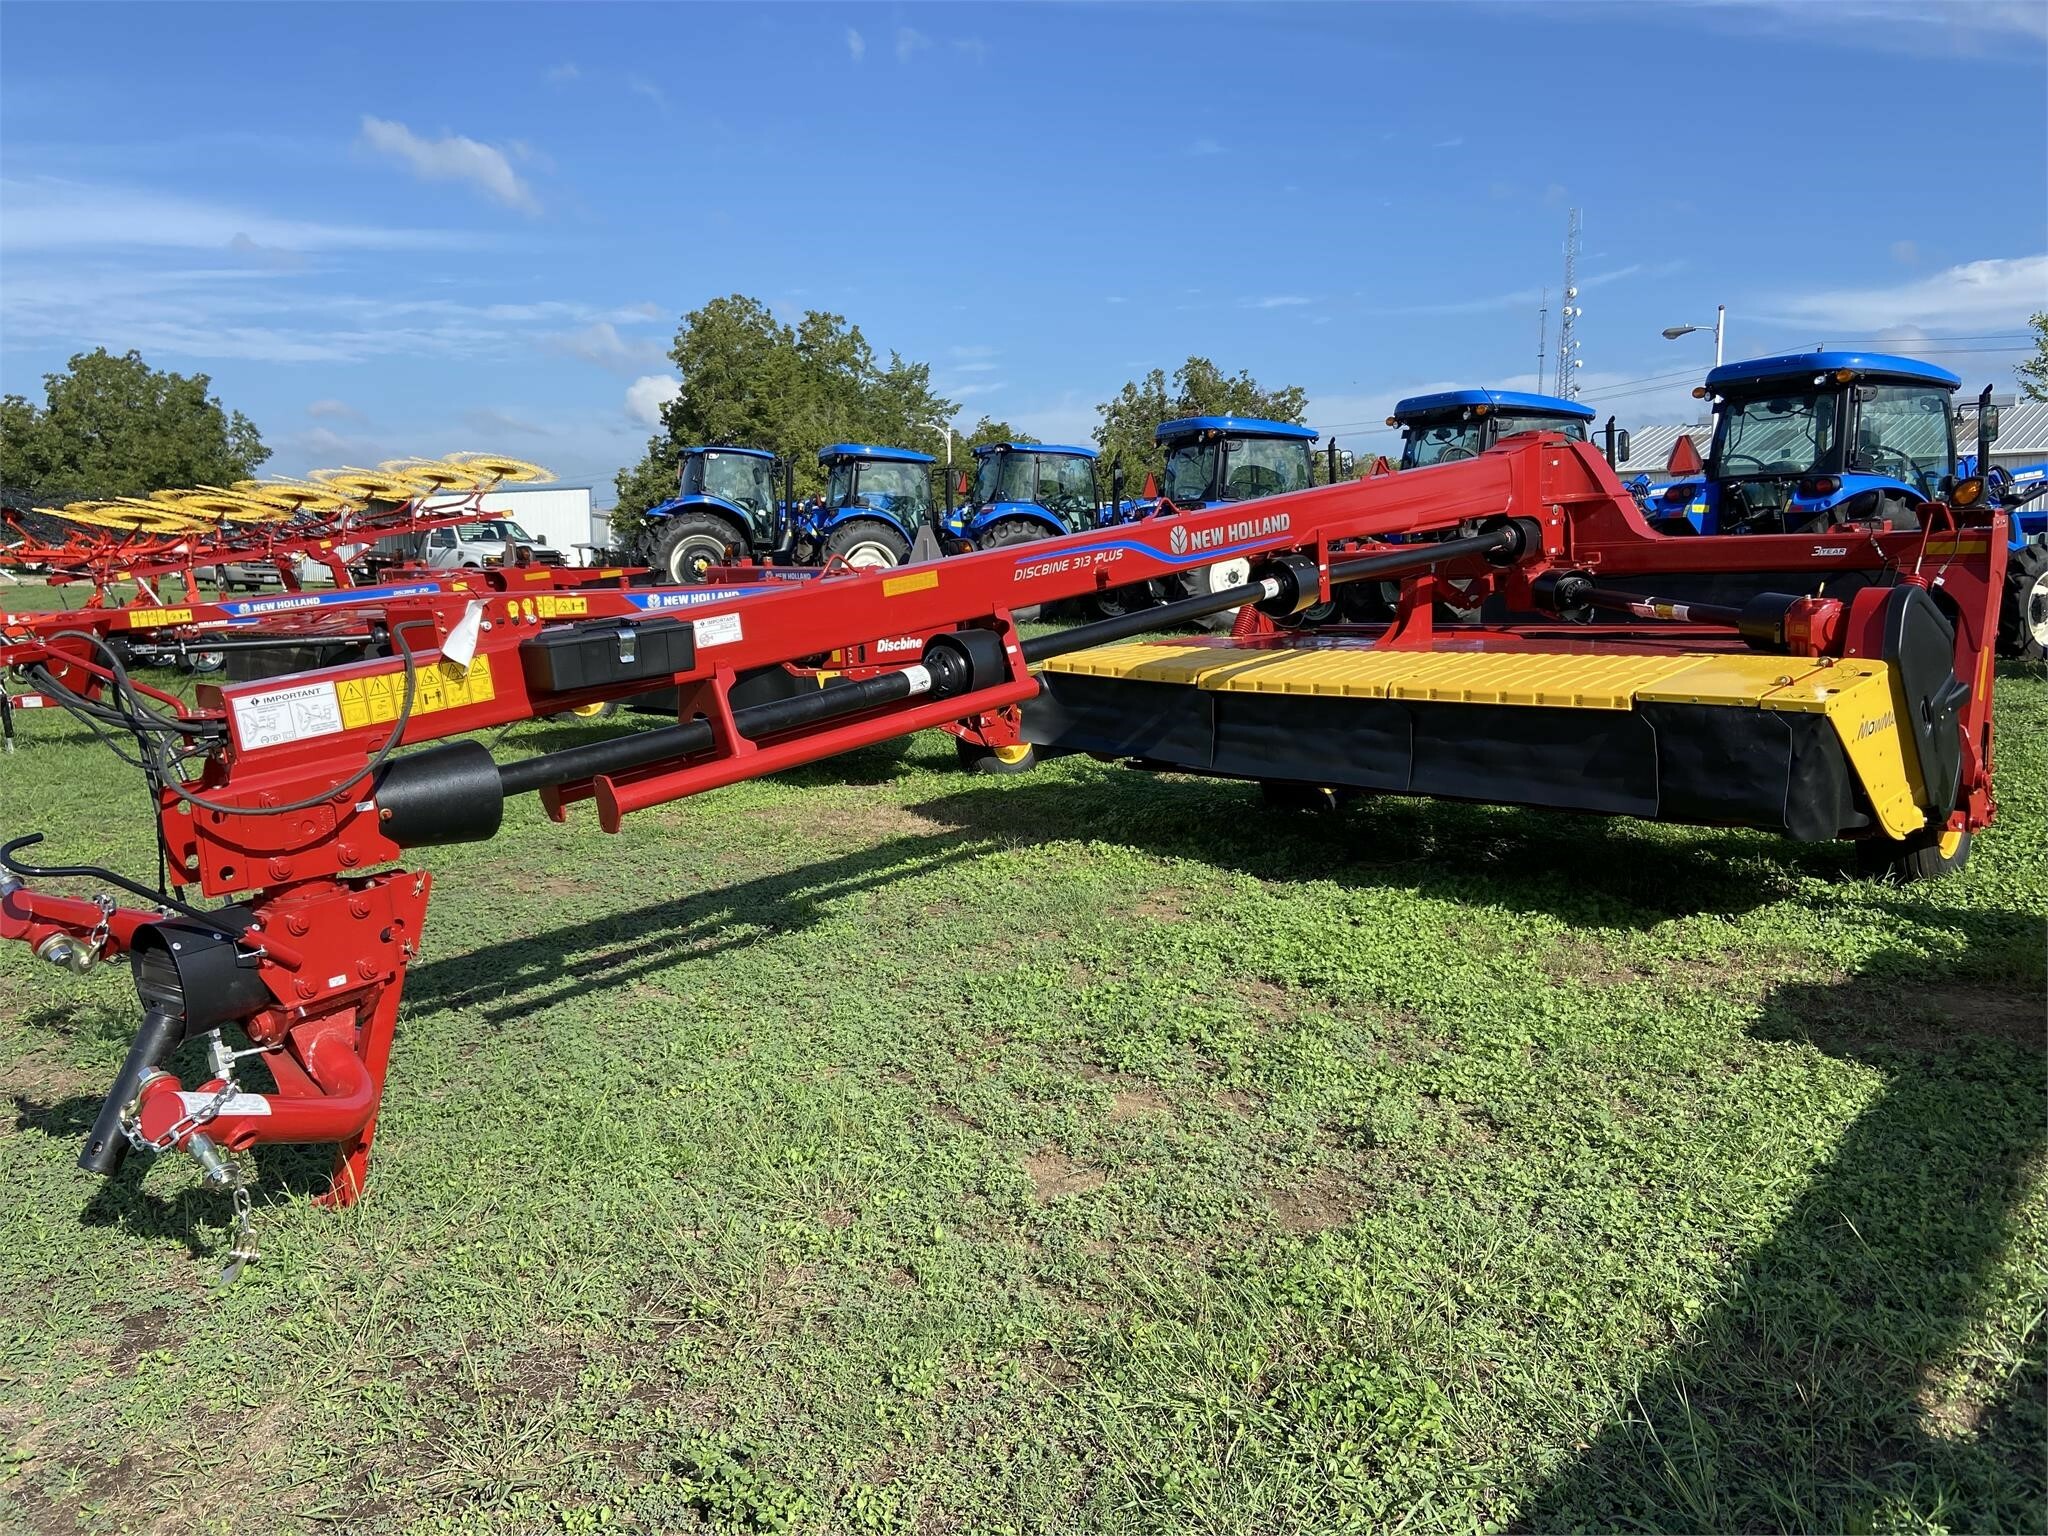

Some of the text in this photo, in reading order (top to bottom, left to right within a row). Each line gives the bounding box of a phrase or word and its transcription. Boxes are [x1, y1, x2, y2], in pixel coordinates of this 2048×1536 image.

[1190, 513, 1290, 551] NEW HOLLAND
[1013, 549, 1124, 582] DISCBINE 313 PLUS
[787, 572, 812, 580] HOLLAND
[253, 597, 321, 613] NEW HOLLAND
[663, 594, 689, 606] NEW
[877, 637, 923, 653] Discbine
[263, 687, 321, 705] IMPORTANT
